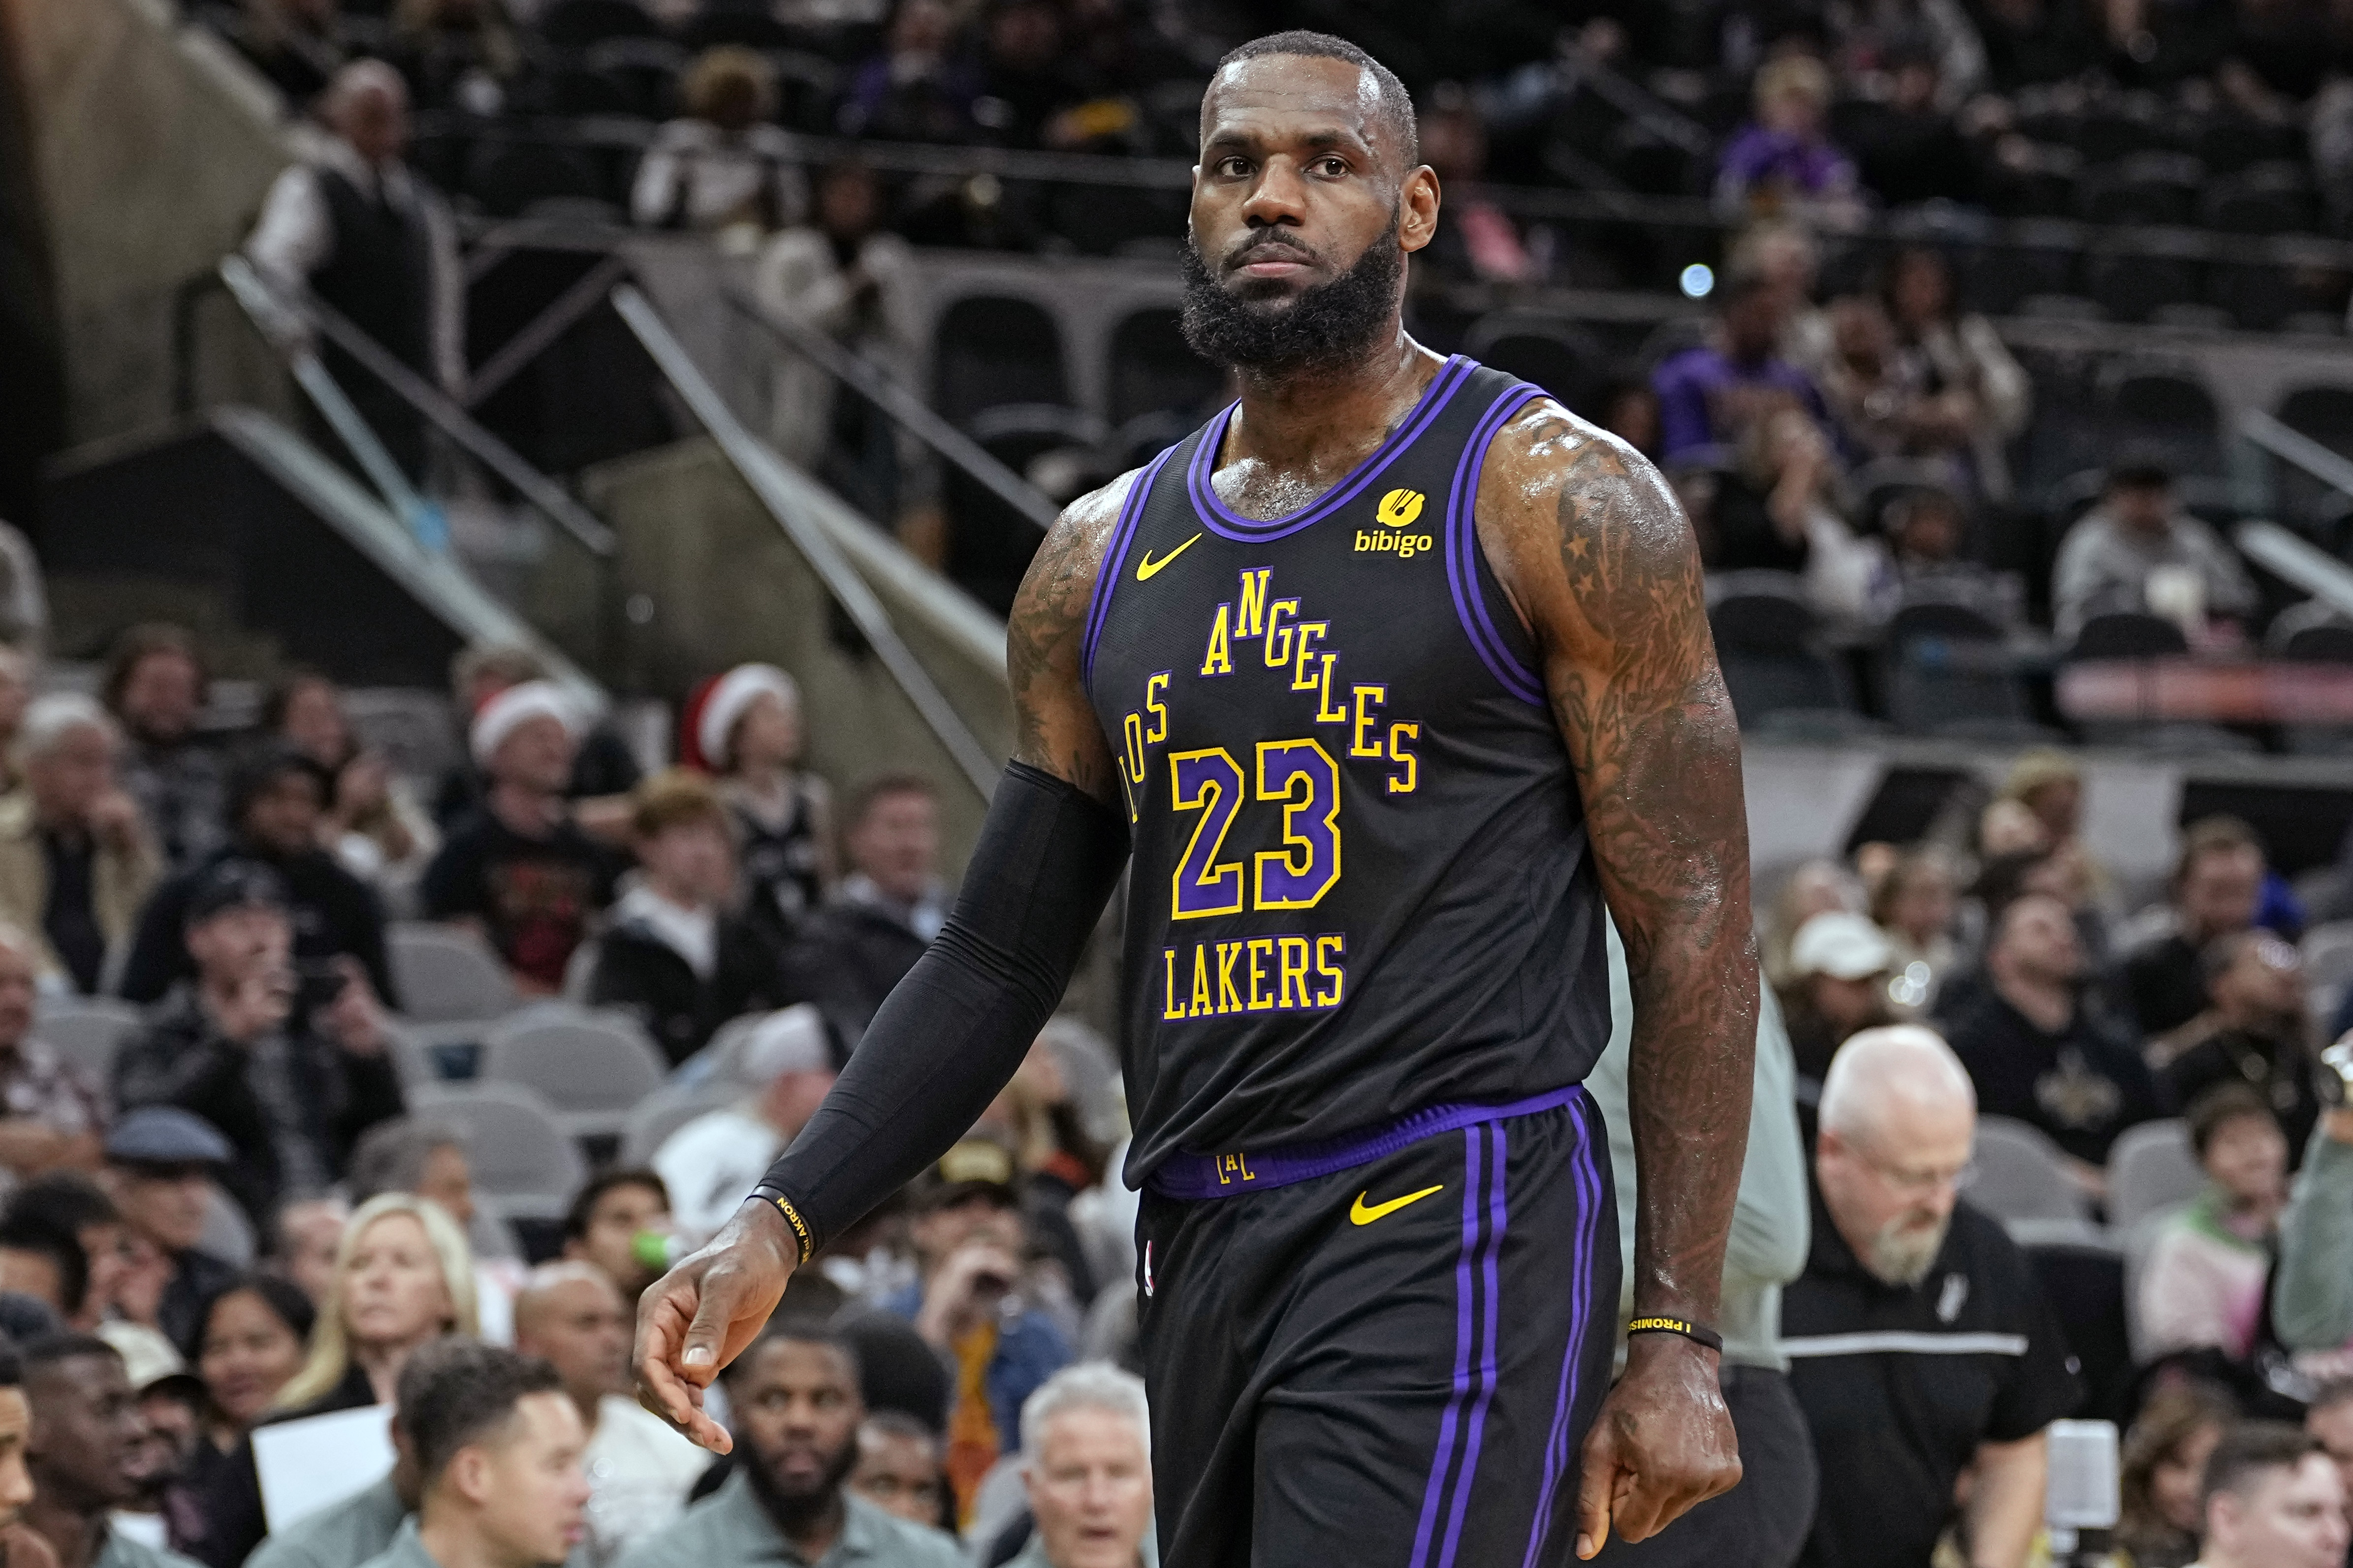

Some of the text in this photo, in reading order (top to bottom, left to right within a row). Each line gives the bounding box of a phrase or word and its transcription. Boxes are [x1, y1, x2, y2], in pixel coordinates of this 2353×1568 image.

[1354, 530, 1433, 558] bibigo
[1117, 565, 1421, 824] LOS ANGELES
[1168, 738, 1341, 921] 23
[1162, 933, 1346, 1022] LAKERS
[776, 1197, 807, 1237] AKRON
[1685, 1323, 1691, 1333] I
